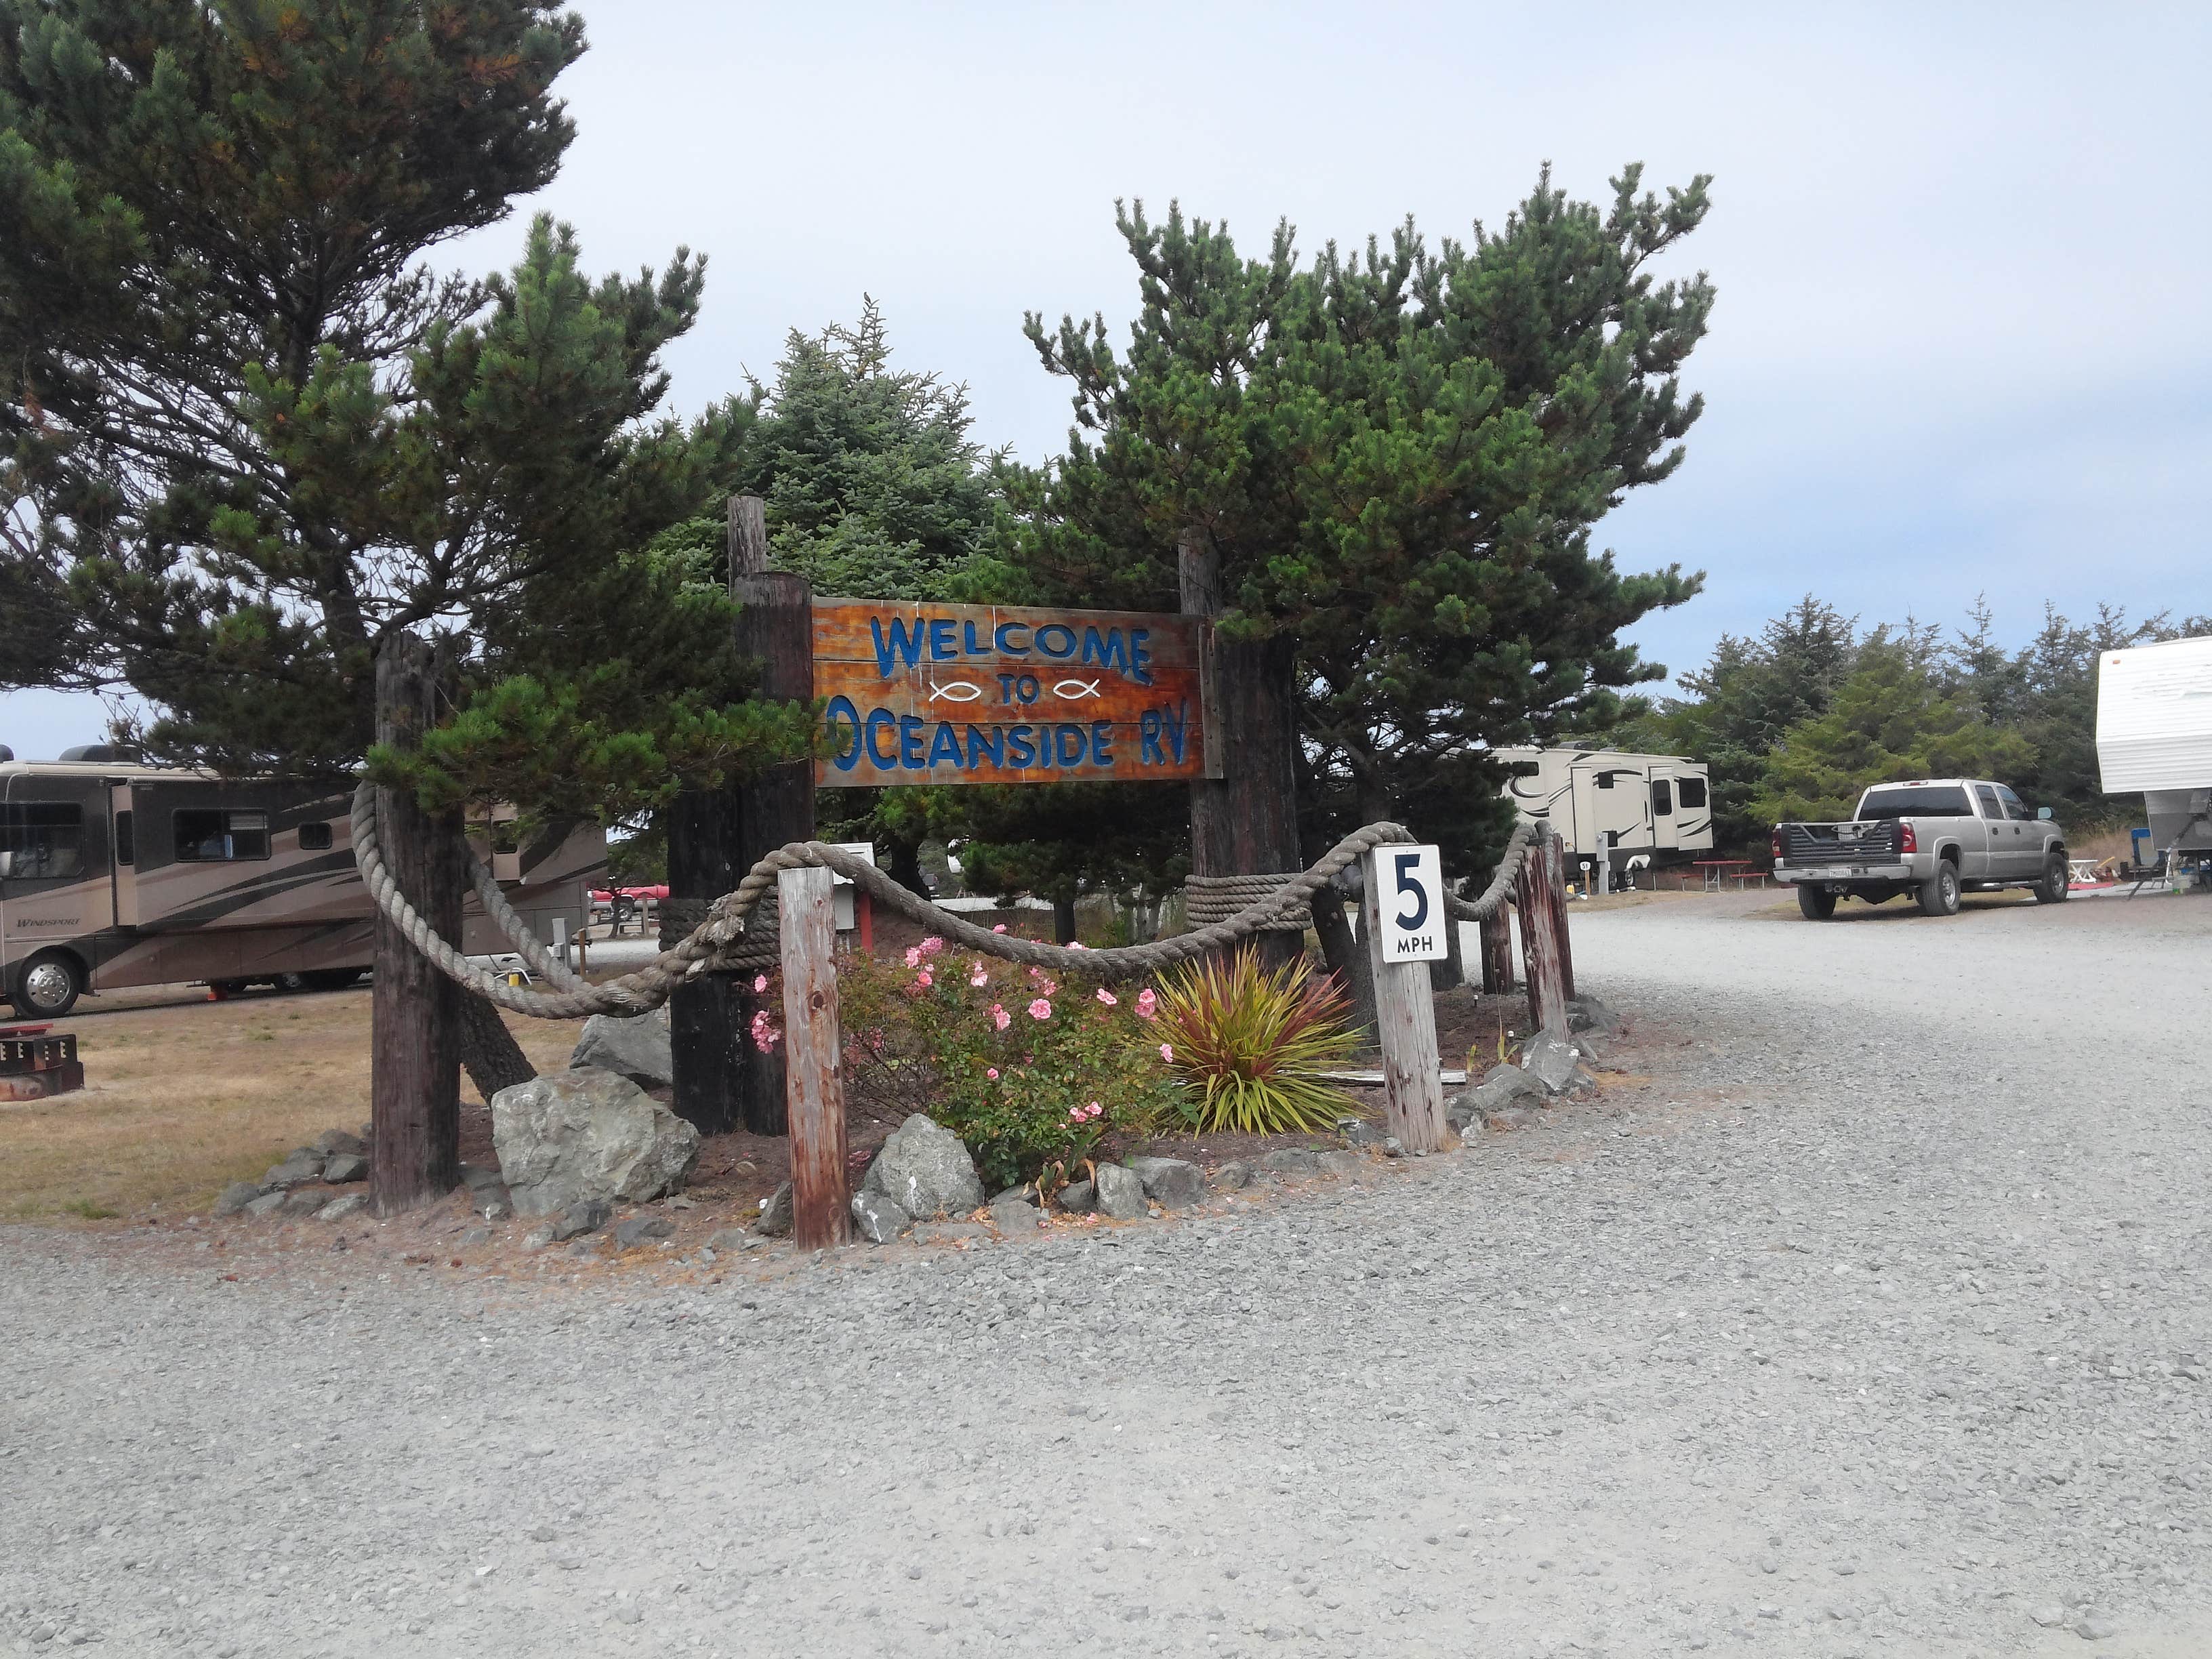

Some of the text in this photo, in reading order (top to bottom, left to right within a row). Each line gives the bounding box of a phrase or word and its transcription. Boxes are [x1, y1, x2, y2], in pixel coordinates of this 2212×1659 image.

[871, 615, 1153, 686] WELCOME
[997, 673, 1040, 705] TO
[826, 695, 1187, 771] OCEANSIDE RV
[1395, 853, 1428, 931] 5
[17, 918, 81, 928] WINDSPORT
[1397, 935, 1433, 954] MPH
